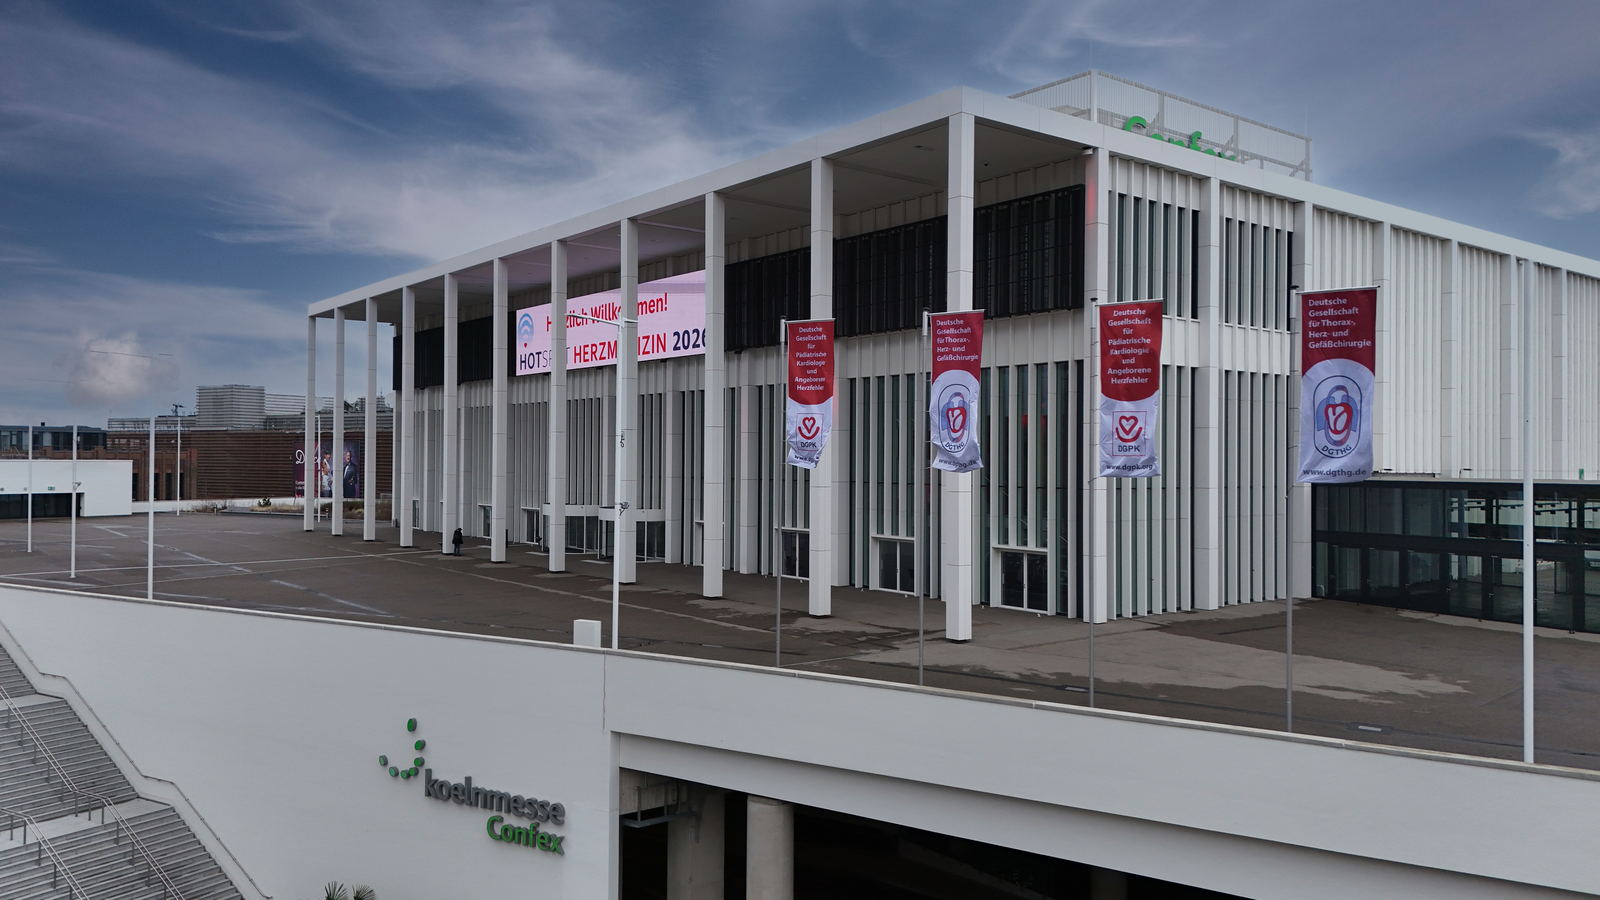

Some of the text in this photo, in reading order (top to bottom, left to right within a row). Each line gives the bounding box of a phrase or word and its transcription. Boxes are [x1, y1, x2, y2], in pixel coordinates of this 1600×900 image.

[1308, 297, 1348, 306] Deutsche
[546, 292, 668, 332] Hzlich Willkmen!
[1113, 308, 1146, 316] Deutsche
[1308, 306, 1359, 317] Gesellschaft
[936, 318, 964, 326] Deutsche
[1108, 317, 1152, 326] Gesellschaft
[1321, 319, 1356, 327] Thorax-,
[936, 327, 972, 335] Gesellschaft
[1332, 329, 1349, 337] und
[796, 334, 827, 342] Gesellschaft
[1108, 337, 1152, 346] Pädiatrische
[1308, 339, 1372, 349] Gefäßchirurgie
[519, 347, 570, 370] HOTS
[574, 333, 667, 364] HERZMIZIN
[1110, 347, 1150, 356] Kardiologie
[1107, 367, 1152, 376] Angeborene
[1111, 376, 1148, 385] Herzfehler
[1321, 444, 1352, 455] DGTHG
[1302, 468, 1367, 477] www.dgthg.de
[424, 768, 566, 826] koelnmesse
[486, 814, 566, 857] Confex
